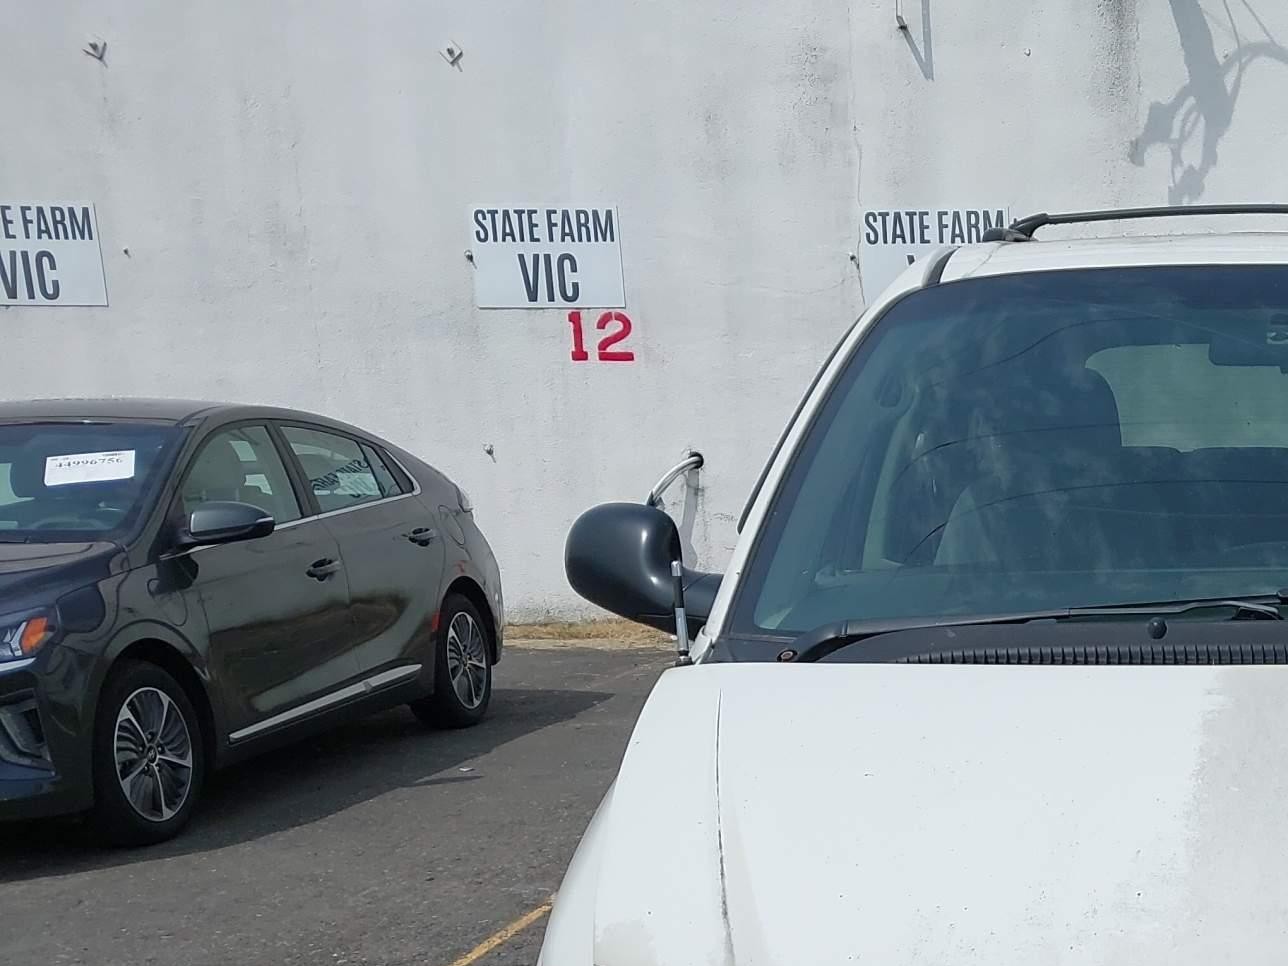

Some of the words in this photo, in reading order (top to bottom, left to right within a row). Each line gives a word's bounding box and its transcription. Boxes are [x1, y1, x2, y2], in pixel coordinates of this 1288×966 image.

[20, 205, 94, 241] FARM
[473, 208, 541, 243] STATE
[546, 208, 616, 243] FARM
[864, 210, 931, 245] STATE
[516, 252, 580, 303] VIC
[567, 310, 635, 362] 12
